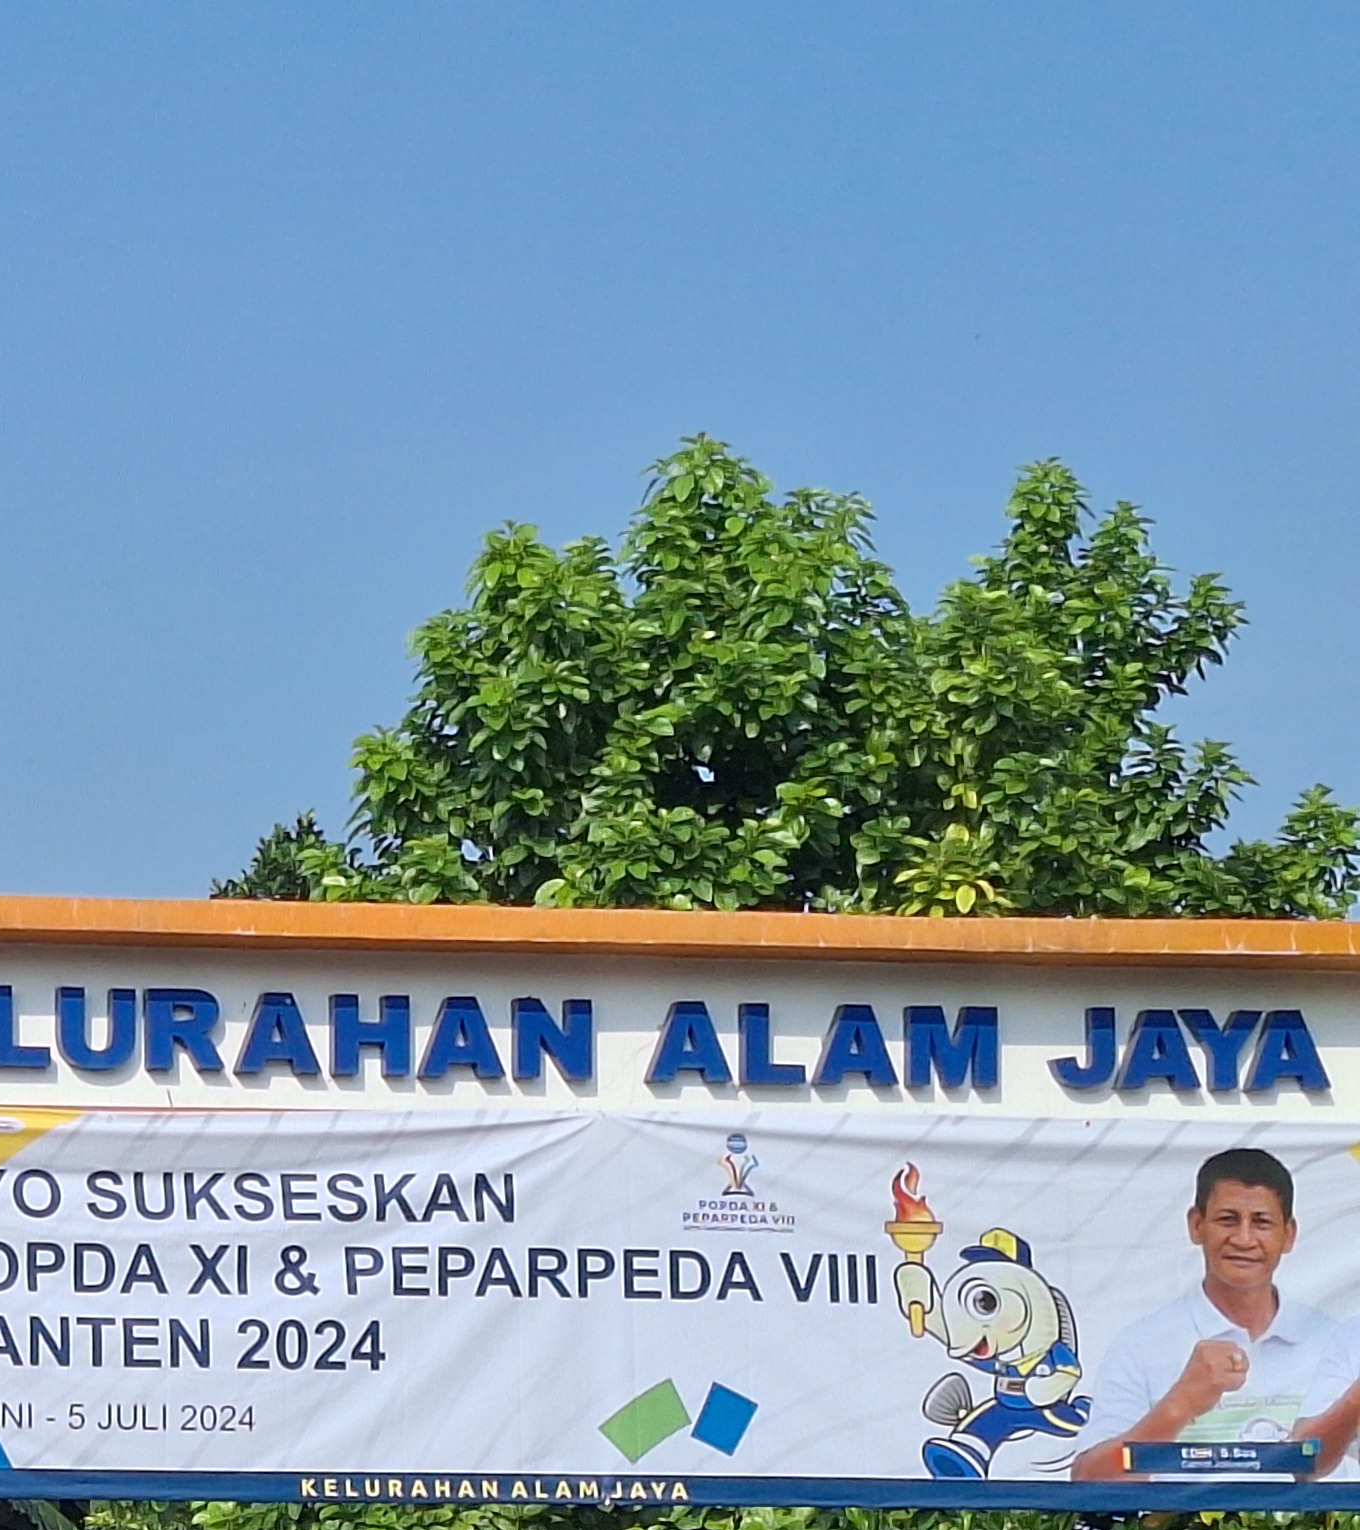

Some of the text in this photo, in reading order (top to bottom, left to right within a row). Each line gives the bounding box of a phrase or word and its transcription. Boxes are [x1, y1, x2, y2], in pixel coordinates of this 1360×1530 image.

[644, 1000, 1000, 1091] ALAM
[1047, 1006, 1333, 1093] JAYA
[86, 1168, 516, 1225] SUKSESKAN
[186, 1243, 251, 1297] XI
[273, 1244, 323, 1299] &
[345, 1245, 765, 1304] PEPARPEDA
[780, 1251, 879, 1306] VIII
[237, 1319, 387, 1373] 2024
[67, 1405, 86, 1431] 5
[97, 1405, 170, 1432] JULI
[179, 1405, 257, 1434] 2024
[300, 1478, 689, 1501] KELURAHAN ALAM JAYA
